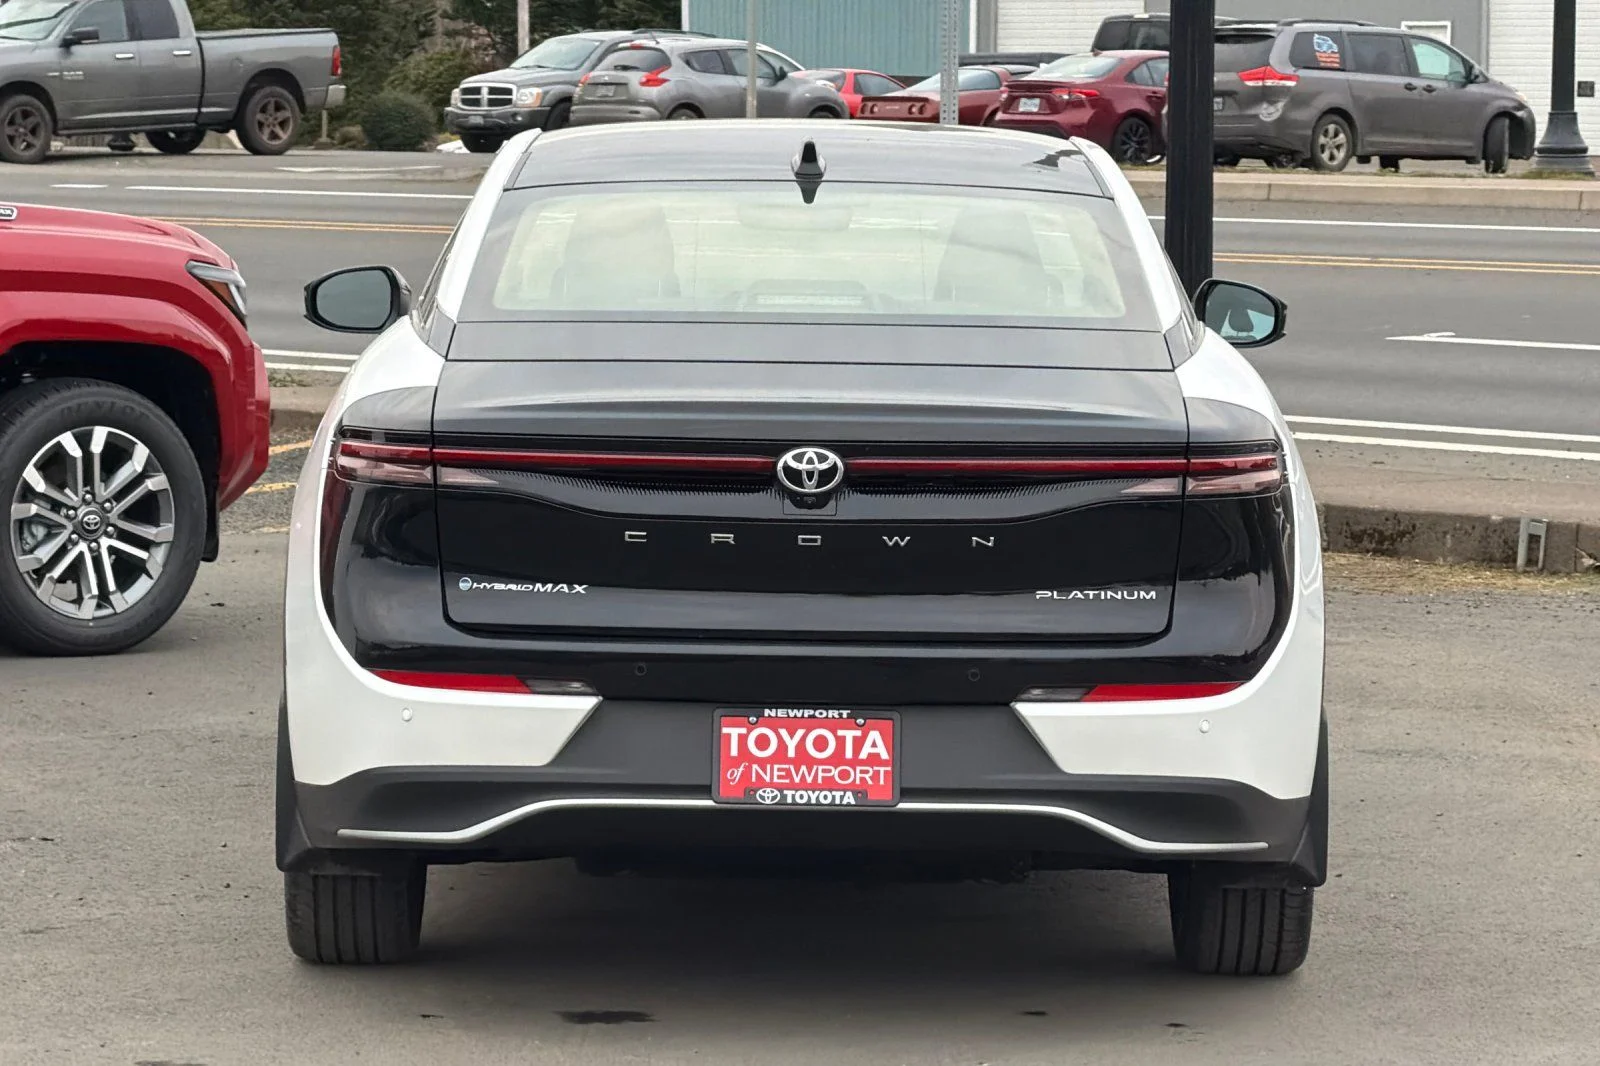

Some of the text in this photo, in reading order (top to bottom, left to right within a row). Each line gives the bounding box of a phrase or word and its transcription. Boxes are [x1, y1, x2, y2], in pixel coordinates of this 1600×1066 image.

[624, 530, 995, 548] CROWN
[1035, 590, 1157, 600] PLATINUM
[763, 708, 851, 719] NEWPORT
[721, 726, 890, 760] TOYOTA
[727, 762, 892, 785] of NEWPORT
[783, 789, 856, 805] TOYOTA
